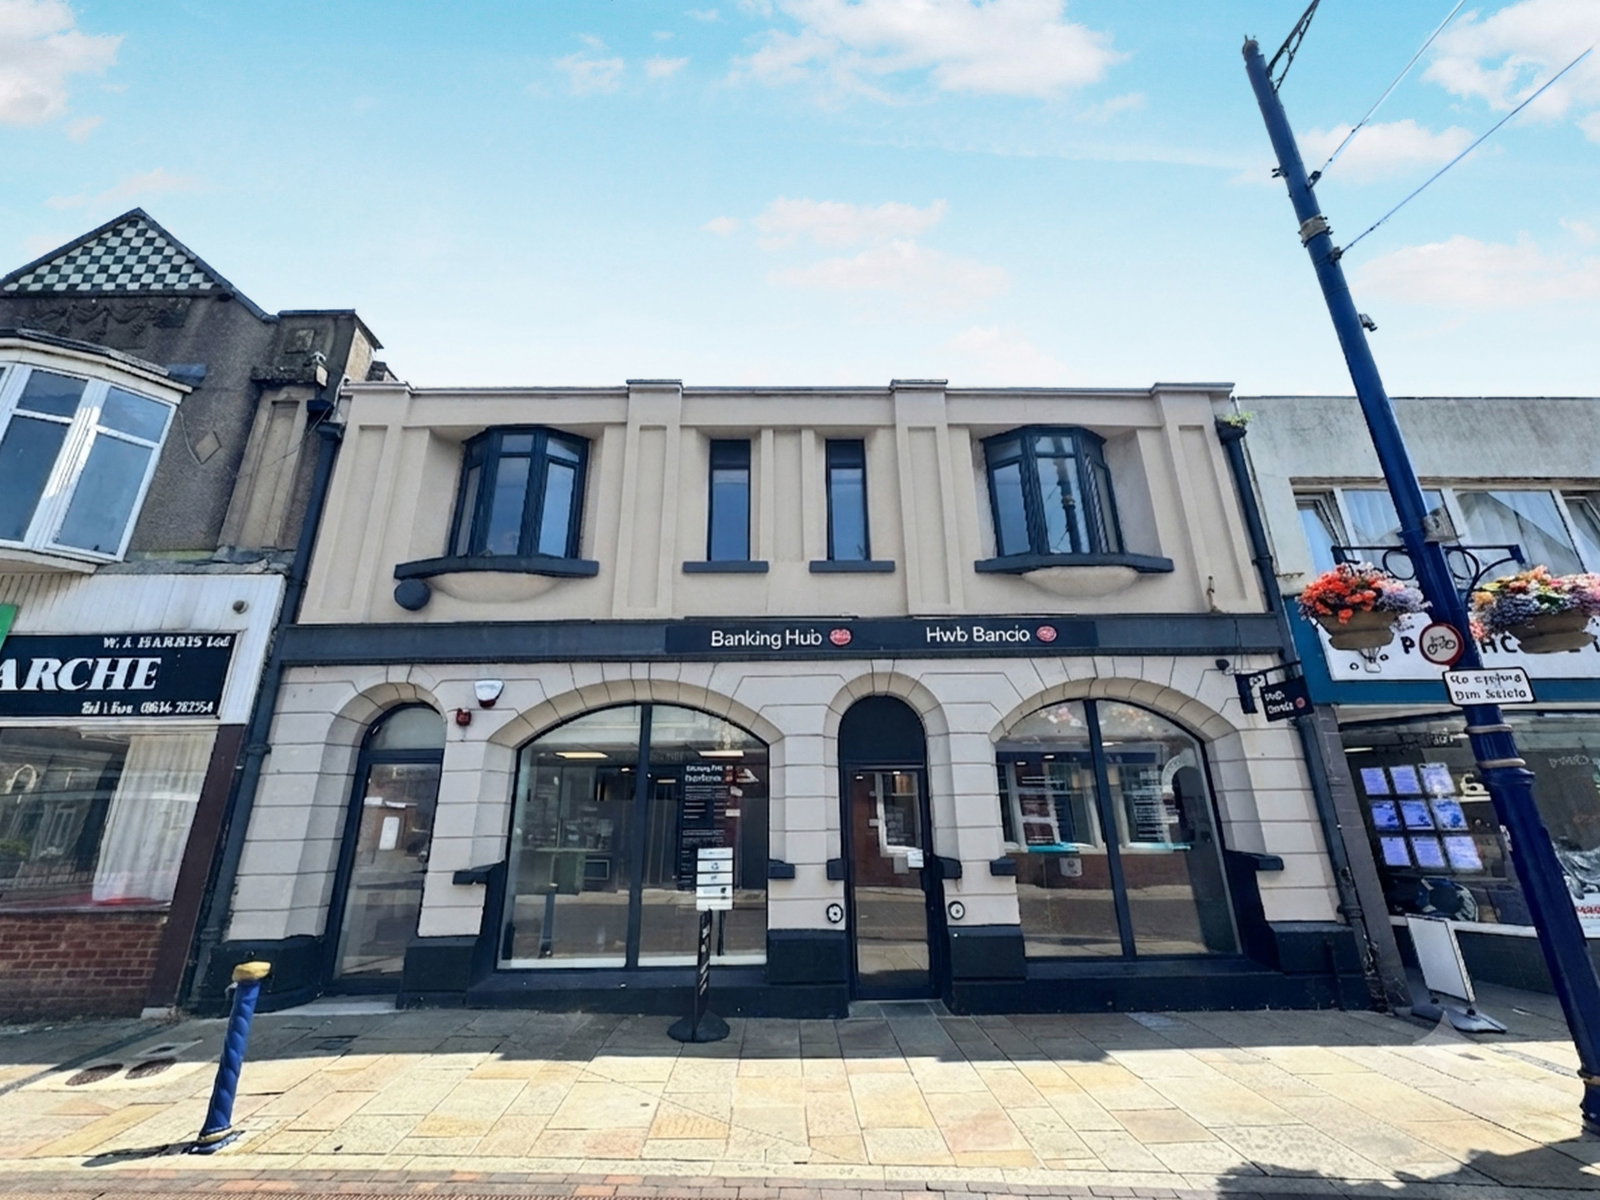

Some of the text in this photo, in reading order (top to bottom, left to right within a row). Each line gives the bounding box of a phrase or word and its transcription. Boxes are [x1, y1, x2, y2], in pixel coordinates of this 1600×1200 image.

[711, 629, 823, 650] Banking Hub
[925, 624, 1031, 642] Hwb Bancio
